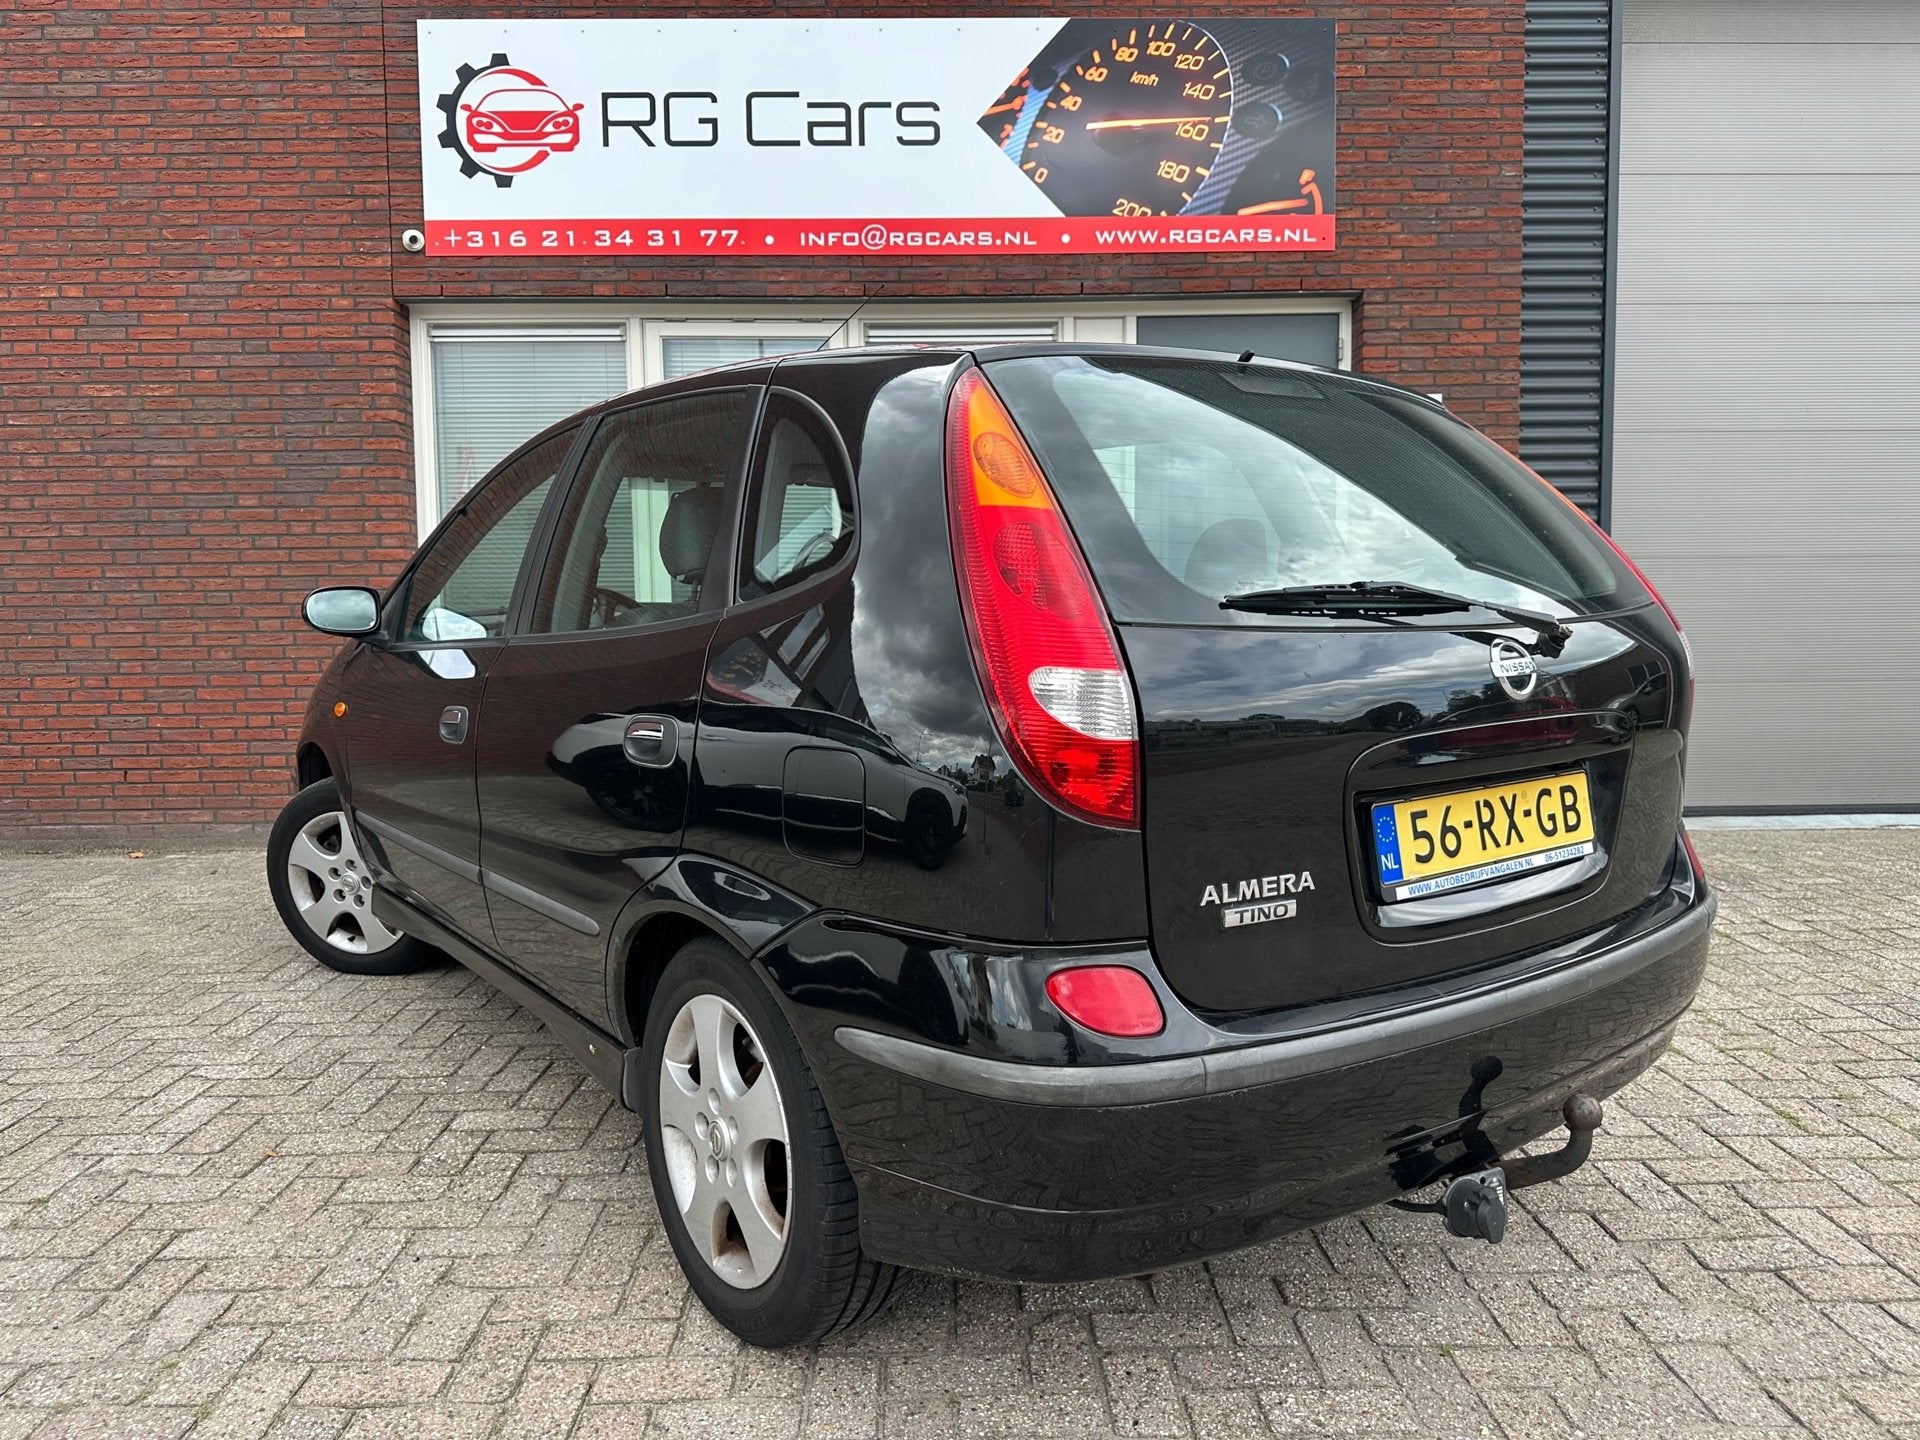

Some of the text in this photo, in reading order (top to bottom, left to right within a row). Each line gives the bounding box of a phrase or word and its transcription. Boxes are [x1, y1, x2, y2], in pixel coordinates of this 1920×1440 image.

[1114, 46, 1139, 63] 80
[1146, 41, 1176, 57] 100
[1174, 54, 1205, 71] 120
[1085, 67, 1108, 82] 60
[1130, 71, 1159, 87] km/h
[1182, 82, 1215, 101] 140
[1060, 95, 1083, 112] 40
[601, 90, 941, 147] RG Cars
[1044, 127, 1064, 143] 20
[1176, 121, 1209, 141] 160
[1157, 159, 1190, 184] 180
[1112, 199, 1151, 216] 200
[444, 229, 527, 247] +316
[594, 230, 633, 247] 34
[647, 229, 681, 246] 31
[800, 224, 1038, 250] INFO@RGCARS.NL
[1095, 228, 1317, 245] WWW.RGCARS.NL
[1409, 784, 1582, 865] 56-RX-GB
[1381, 852, 1399, 871] NL
[1407, 857, 1535, 896] WWW.AUTOBEDRIJFVANGALEN.NL
[1200, 871, 1316, 907] ALMERA
[1234, 903, 1289, 924] TINO
